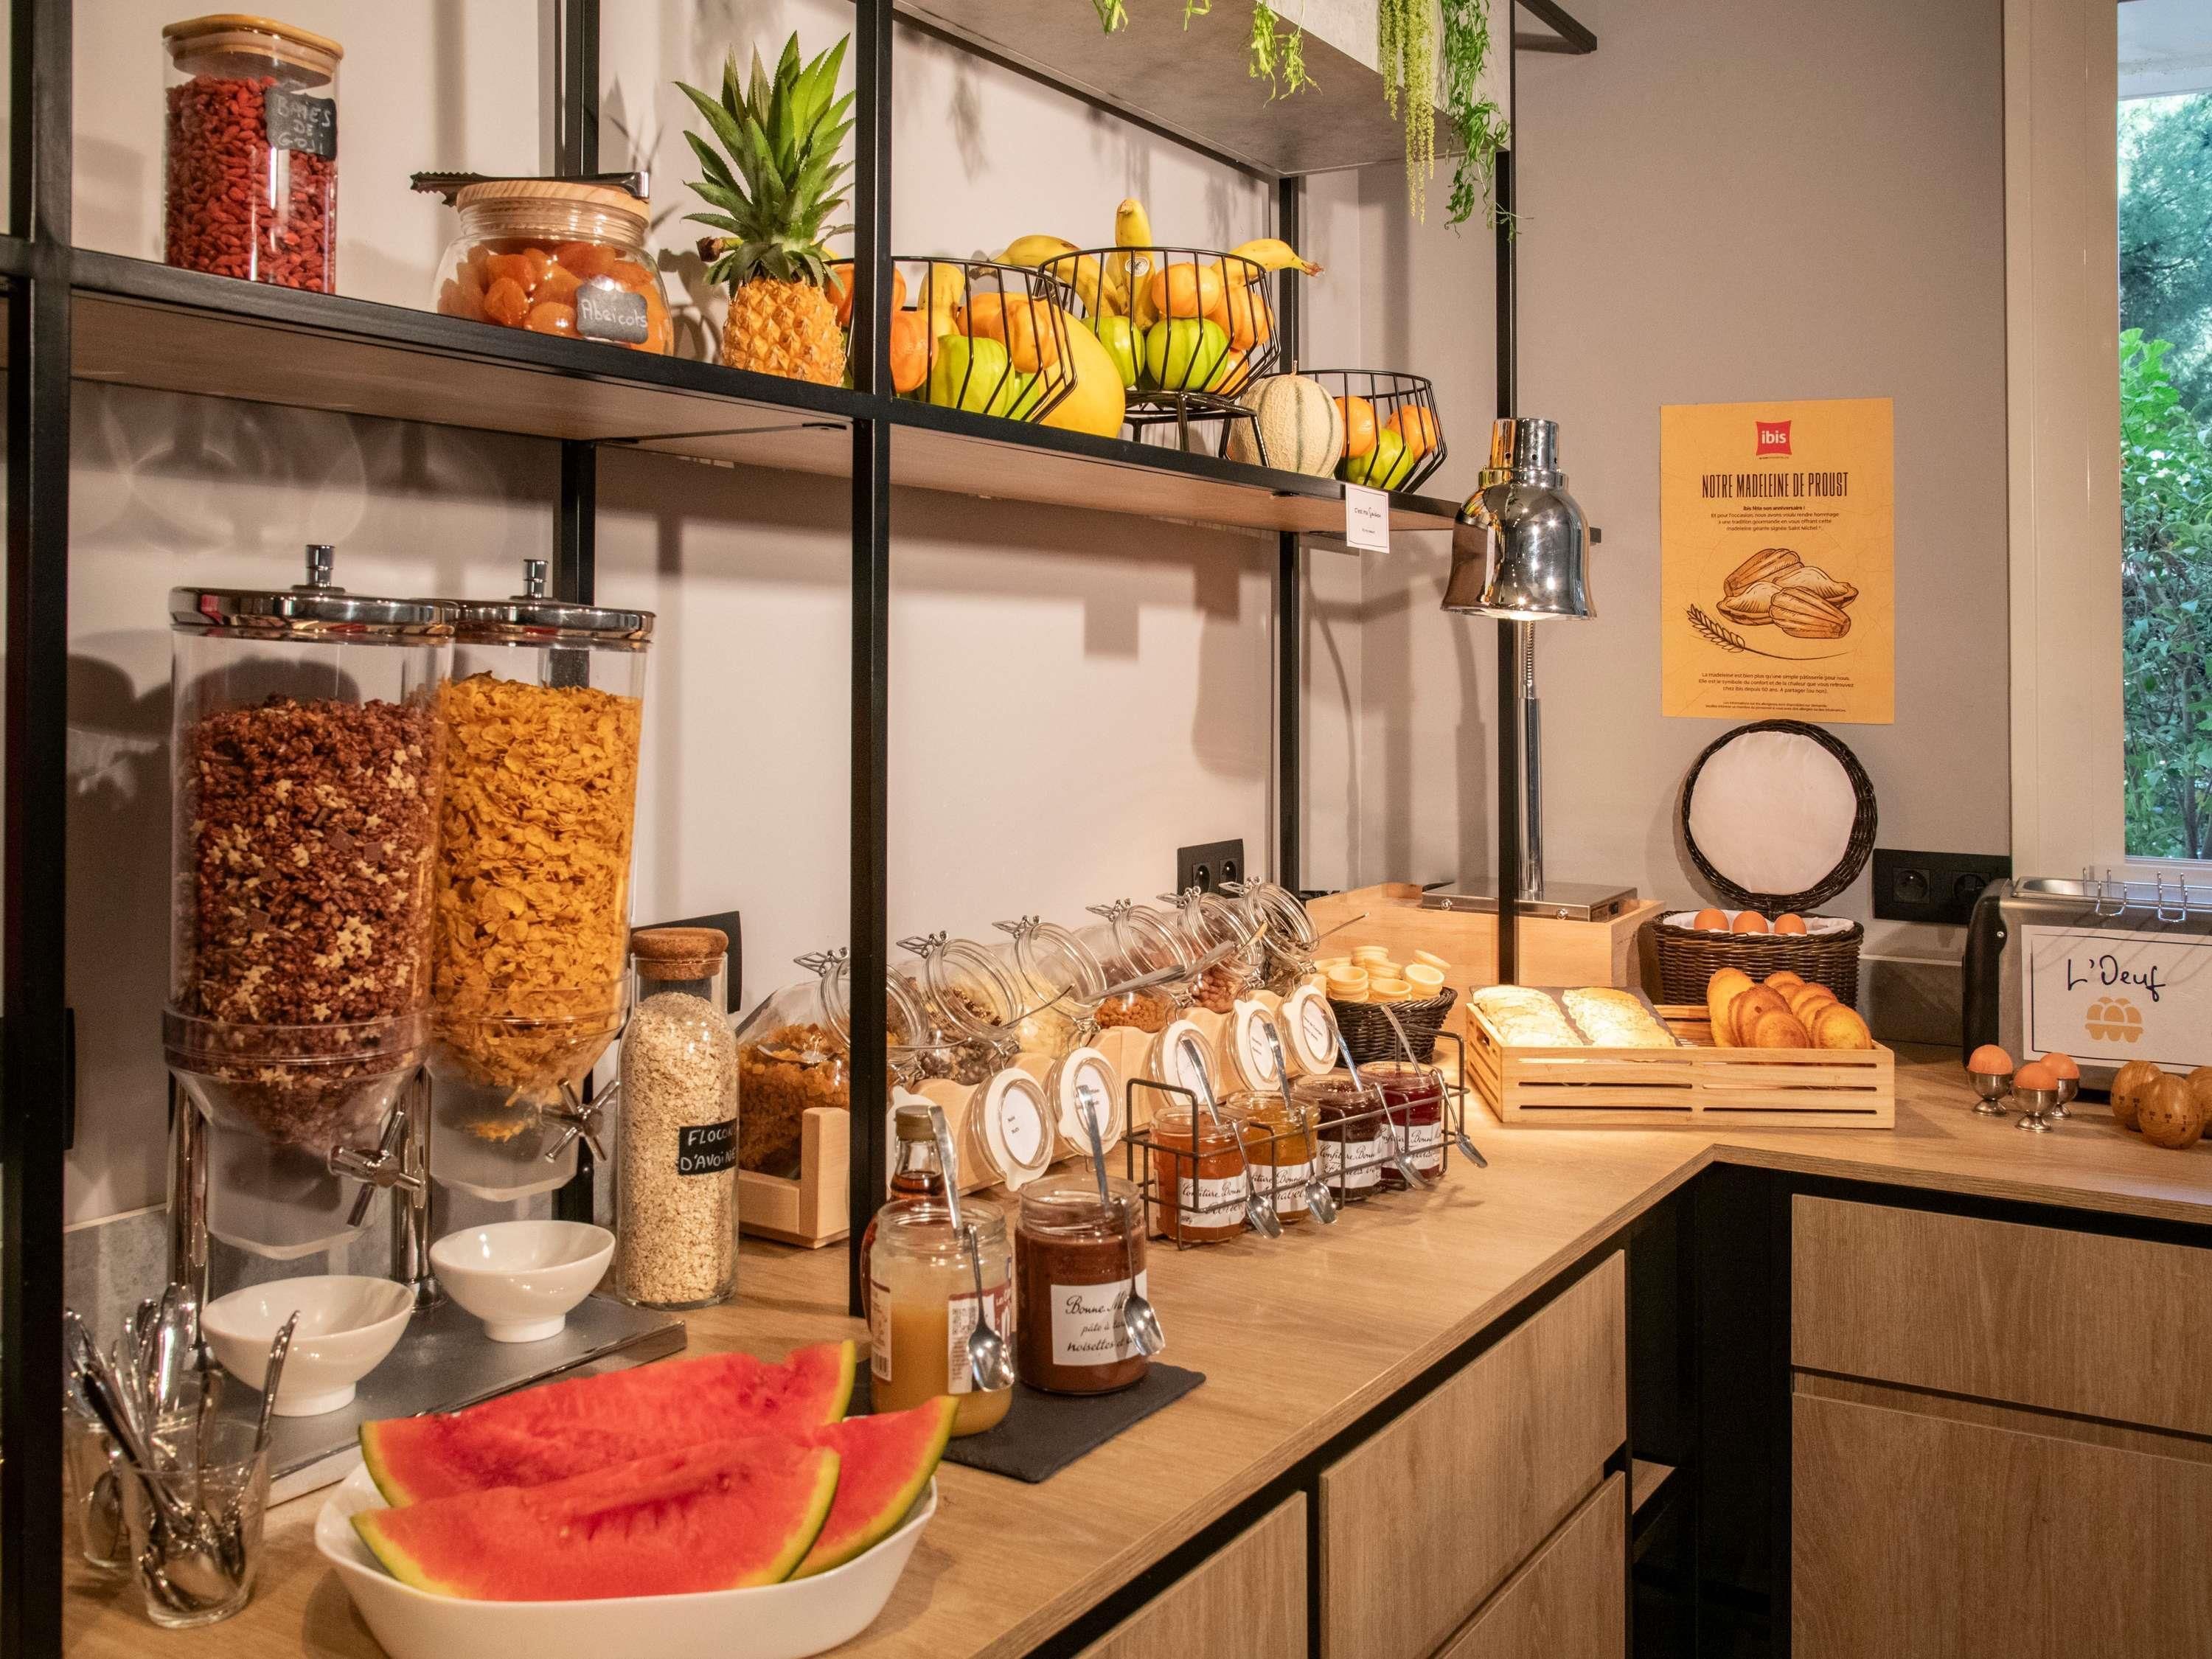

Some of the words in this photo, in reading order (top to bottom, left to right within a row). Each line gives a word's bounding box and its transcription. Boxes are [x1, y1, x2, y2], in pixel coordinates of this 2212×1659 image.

[1761, 430, 1787, 444] ibis
[1702, 474, 1733, 498] NOTRE
[1736, 473, 1789, 498] MADELEINE
[1792, 473, 1804, 497] DE
[1808, 472, 1848, 497] PROUST
[1320, 1144, 1353, 1161] Confitre
[1065, 1295, 1105, 1315] Bonne
[1067, 1339, 1113, 1352] noisettes
